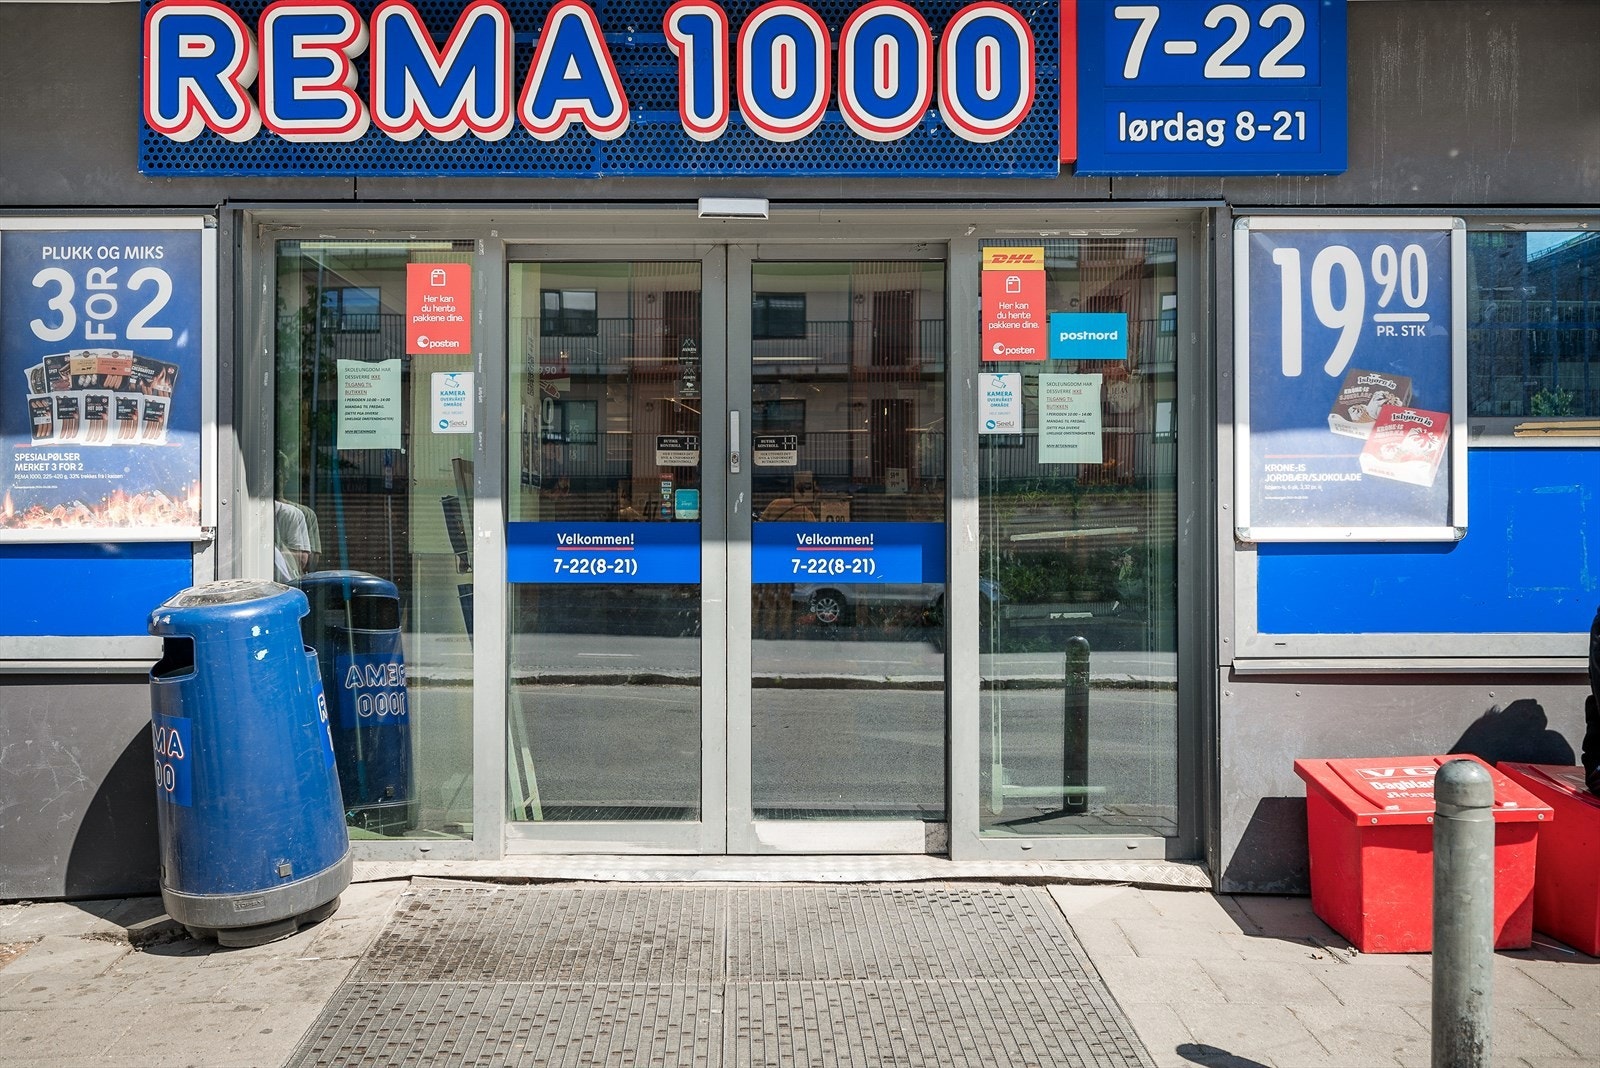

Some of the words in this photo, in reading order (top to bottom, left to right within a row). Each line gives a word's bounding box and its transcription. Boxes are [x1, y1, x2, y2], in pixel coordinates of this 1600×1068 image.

[1113, 3, 1306, 80] 7-22
[144, 0, 629, 142] REMA
[664, 0, 1034, 143] 1000
[1118, 110, 1226, 147] lørdag
[1235, 110, 1306, 142] 8-21
[42, 246, 93, 260] PLUKK
[97, 246, 120, 259] OG
[124, 245, 164, 259] MIKS
[991, 254, 1036, 263] DHL
[30, 267, 77, 342] 3
[85, 266, 118, 341] FOR
[126, 267, 173, 341] 2
[423, 295, 439, 303] Her
[440, 295, 454, 303] kan
[421, 304, 431, 312] du
[432, 304, 456, 312] hente
[998, 302, 1013, 310] Her
[1014, 302, 1029, 310] kan
[1272, 245, 1365, 377] 19
[1371, 244, 1428, 309] 90
[413, 314, 445, 323] pakkene
[446, 314, 464, 322] dine.
[996, 311, 1007, 319] du
[1007, 311, 1031, 319] hente
[988, 321, 1020, 330] pakkene
[1021, 321, 1040, 329] dine.
[1376, 325, 1398, 337] PR.
[1401, 325, 1426, 337] STK
[1060, 331, 1118, 342] postnord
[430, 340, 459, 349] posten
[1005, 346, 1035, 356] posten
[14, 452, 80, 462] SPESIALPØLSER
[14, 462, 50, 471] MERKET
[51, 462, 57, 471] 3
[58, 462, 76, 471] FOR
[77, 462, 83, 471] 2
[1264, 464, 1306, 472] KRONE-IS
[1264, 473, 1362, 482] JORDBÆR/SJOKOLADE
[557, 532, 634, 546] Velkommen!
[796, 532, 873, 546] Velkommen!
[554, 558, 638, 575] 7-22(8-21)
[791, 558, 876, 575] 7-22(8-21)
[153, 723, 184, 759] MA
[155, 759, 175, 791] 00
[1361, 767, 1437, 777] VG
